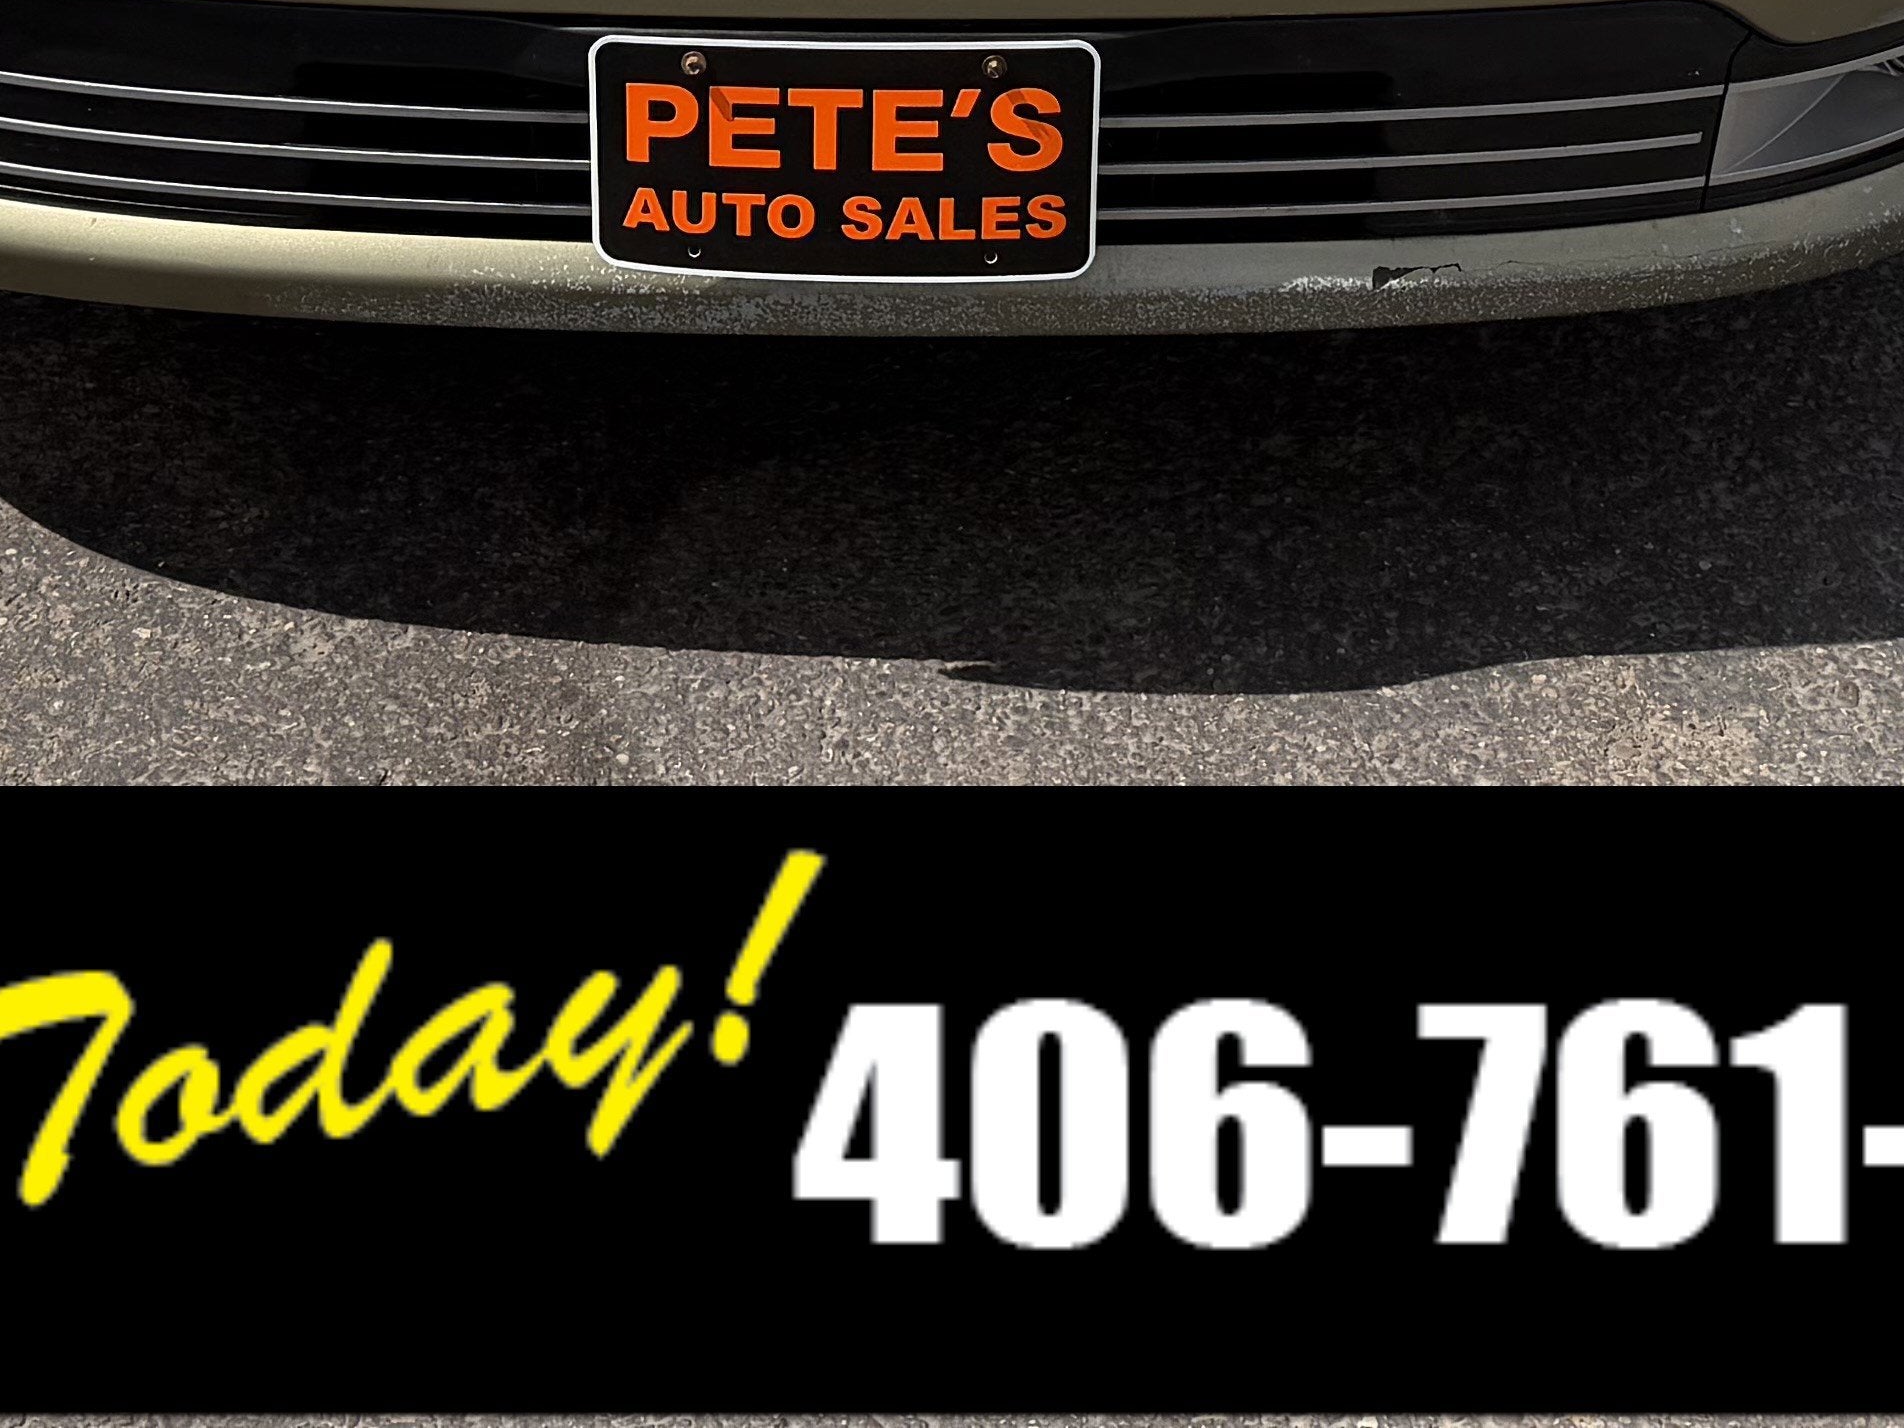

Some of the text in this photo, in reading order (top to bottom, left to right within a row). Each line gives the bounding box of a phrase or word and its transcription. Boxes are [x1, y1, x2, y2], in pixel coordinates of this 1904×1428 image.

[624, 82, 1064, 173] PETE'S
[621, 187, 1068, 242] AUTO SALES
